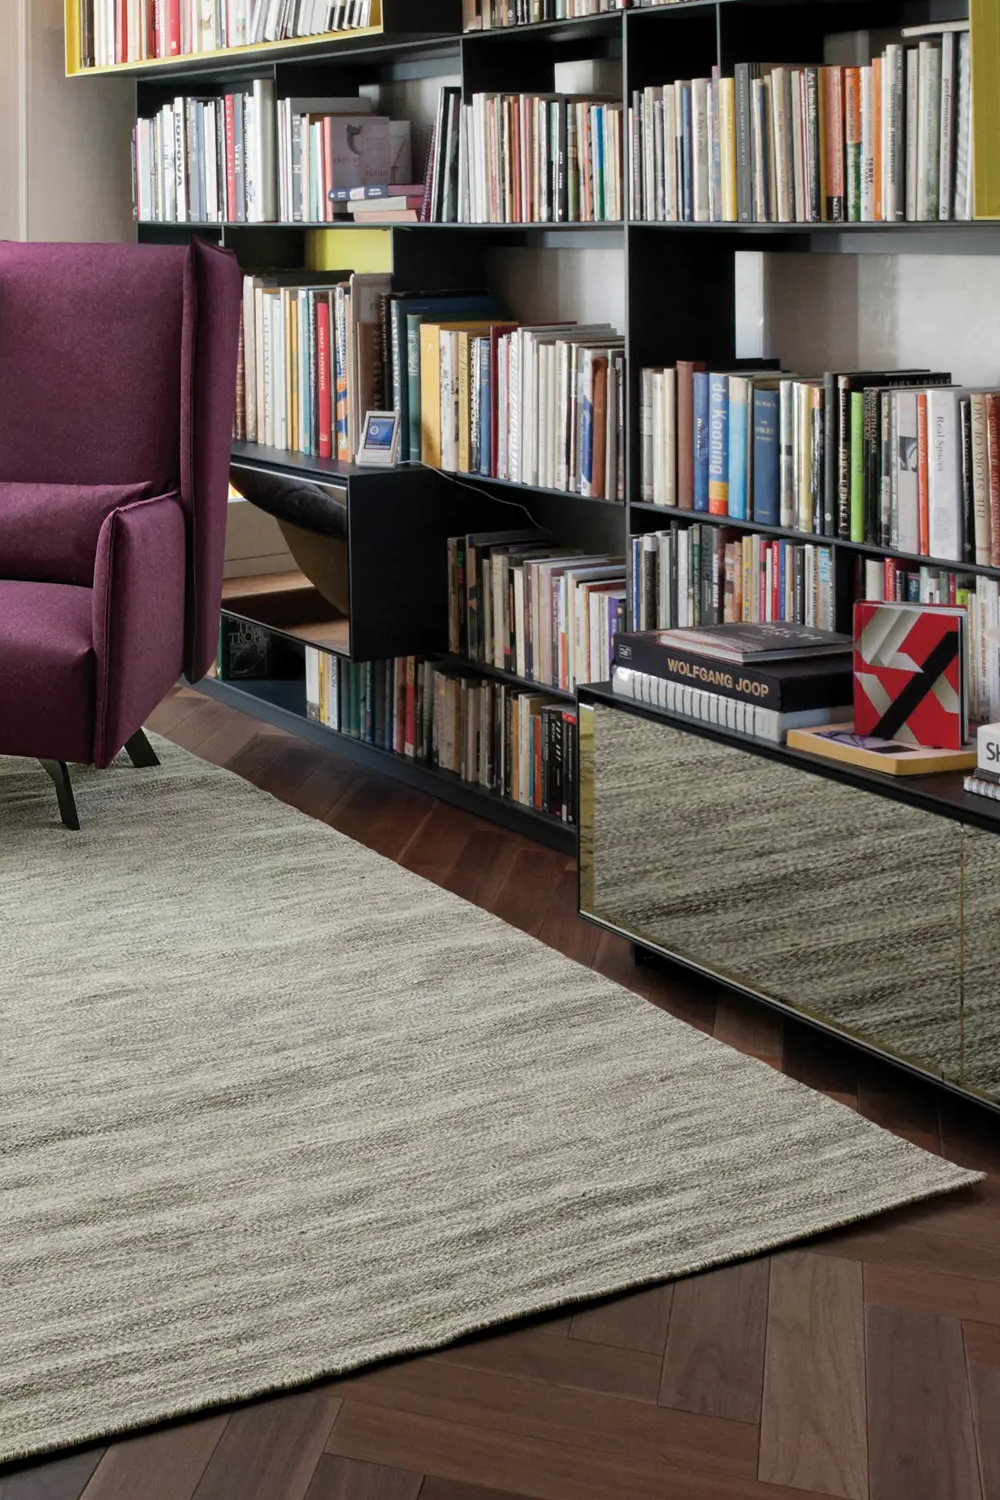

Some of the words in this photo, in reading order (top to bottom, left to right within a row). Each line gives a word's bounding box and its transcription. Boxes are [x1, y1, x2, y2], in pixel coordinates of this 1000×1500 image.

[943, 78, 951, 137] performance
[712, 383, 725, 401] de
[974, 402, 983, 422] ART
[936, 416, 945, 438] Real
[974, 432, 983, 449] OF
[710, 410, 726, 475] Kooning
[935, 440, 945, 473] Spaces
[974, 449, 985, 491] STORY
[976, 496, 986, 520] THE
[667, 657, 733, 689] WOLFGANG
[735, 677, 770, 698] JOOP
